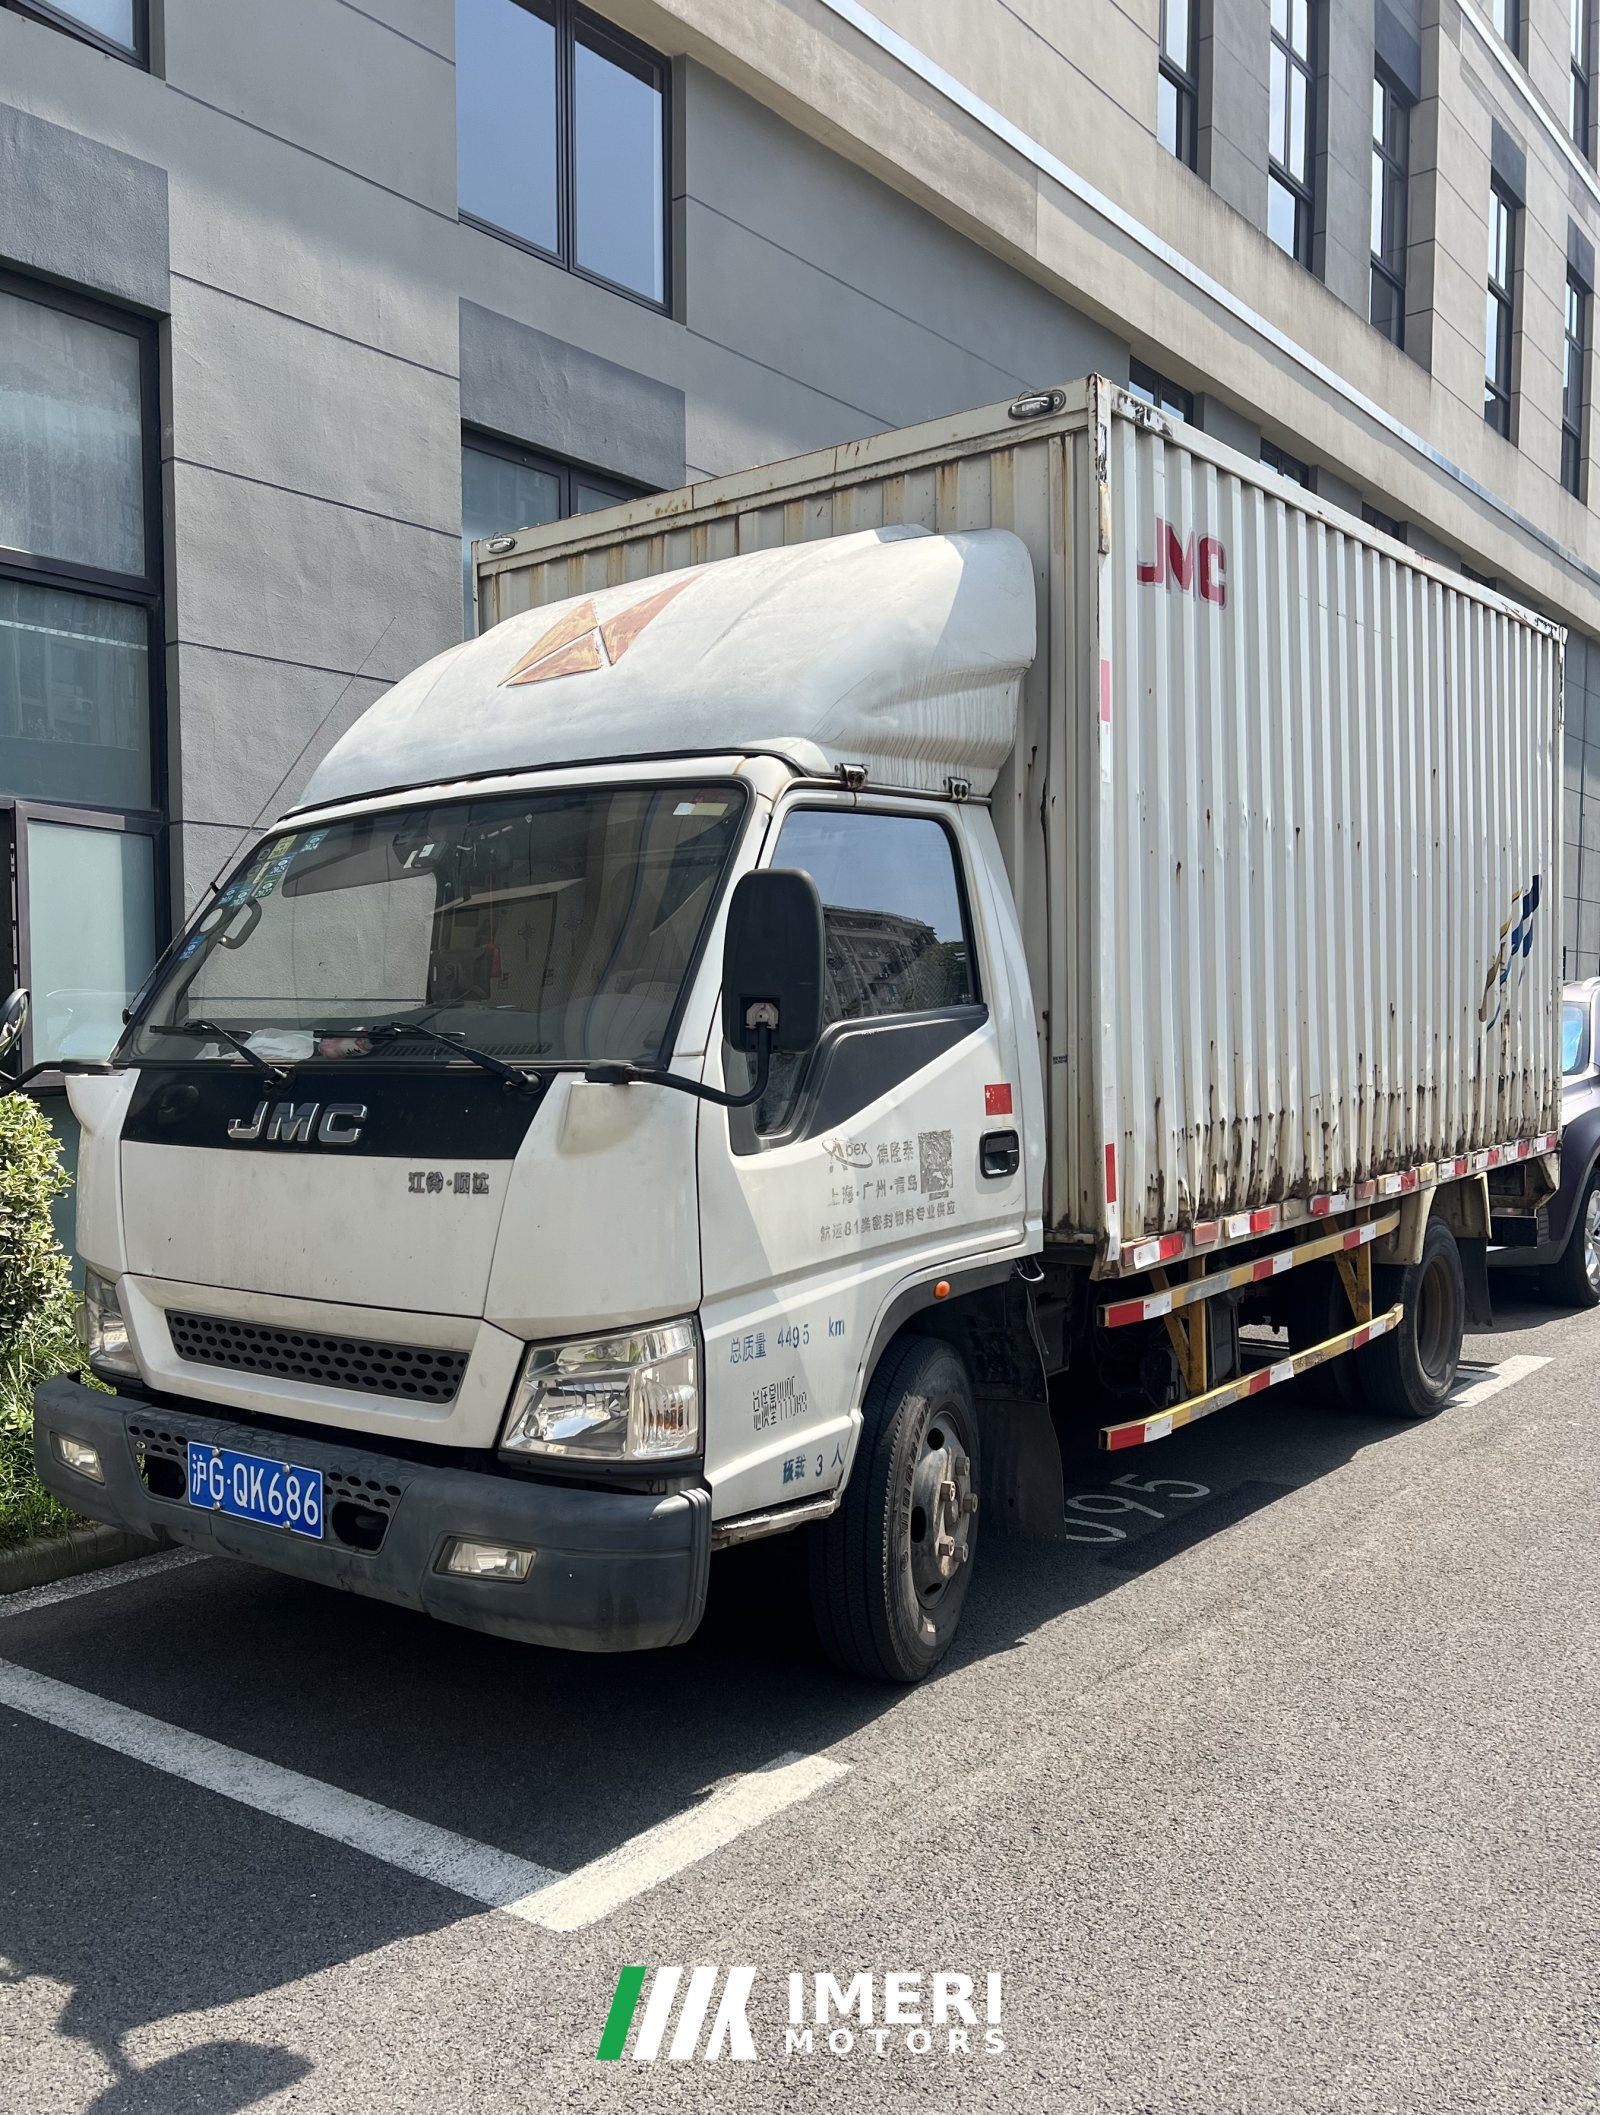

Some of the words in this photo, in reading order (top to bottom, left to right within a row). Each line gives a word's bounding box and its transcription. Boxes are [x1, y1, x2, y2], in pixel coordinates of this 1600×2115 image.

[1136, 514, 1226, 610] JMC
[227, 1101, 368, 1143] JMC
[730, 1332, 767, 1364] 总质量
[777, 1324, 810, 1348] 4495
[815, 1454, 824, 1477] 3
[831, 1442, 843, 1468] 人
